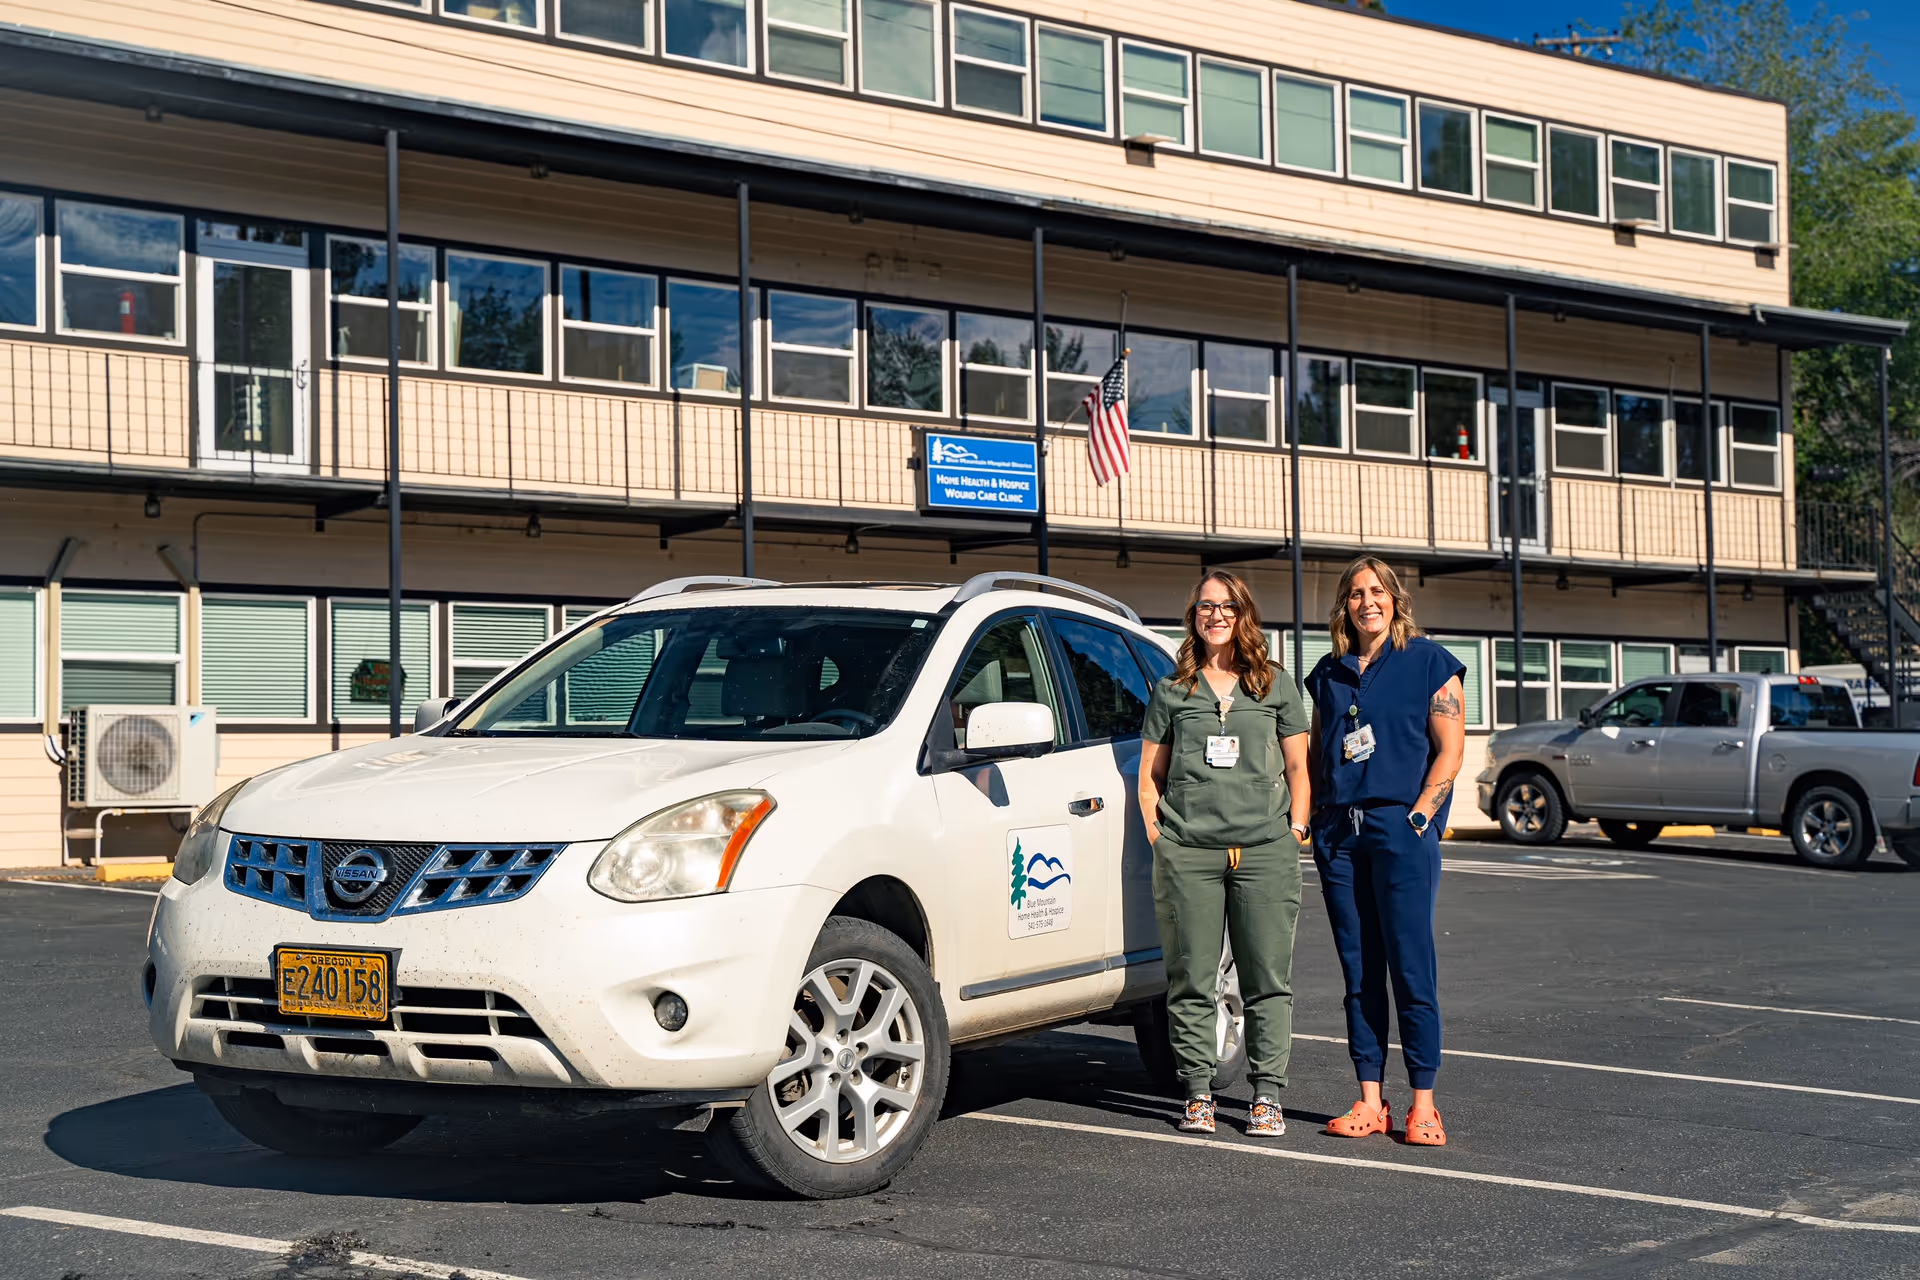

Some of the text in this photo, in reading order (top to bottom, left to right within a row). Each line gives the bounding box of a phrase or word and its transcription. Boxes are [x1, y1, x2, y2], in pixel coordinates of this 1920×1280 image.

[1011, 461, 1033, 469] District
[936, 474, 1030, 490] HOME HEALTH & HOSPICE
[944, 488, 1024, 503] WOUND CARE CLINIC
[335, 869, 378, 878] NISSAN
[1027, 896, 1056, 908] Blue Mountain
[1017, 906, 1064, 921] Home Health & Hospice
[310, 955, 353, 966] OREGON
[283, 965, 382, 1004] E240158
[284, 999, 383, 1012] PUBLICLY OWNED
